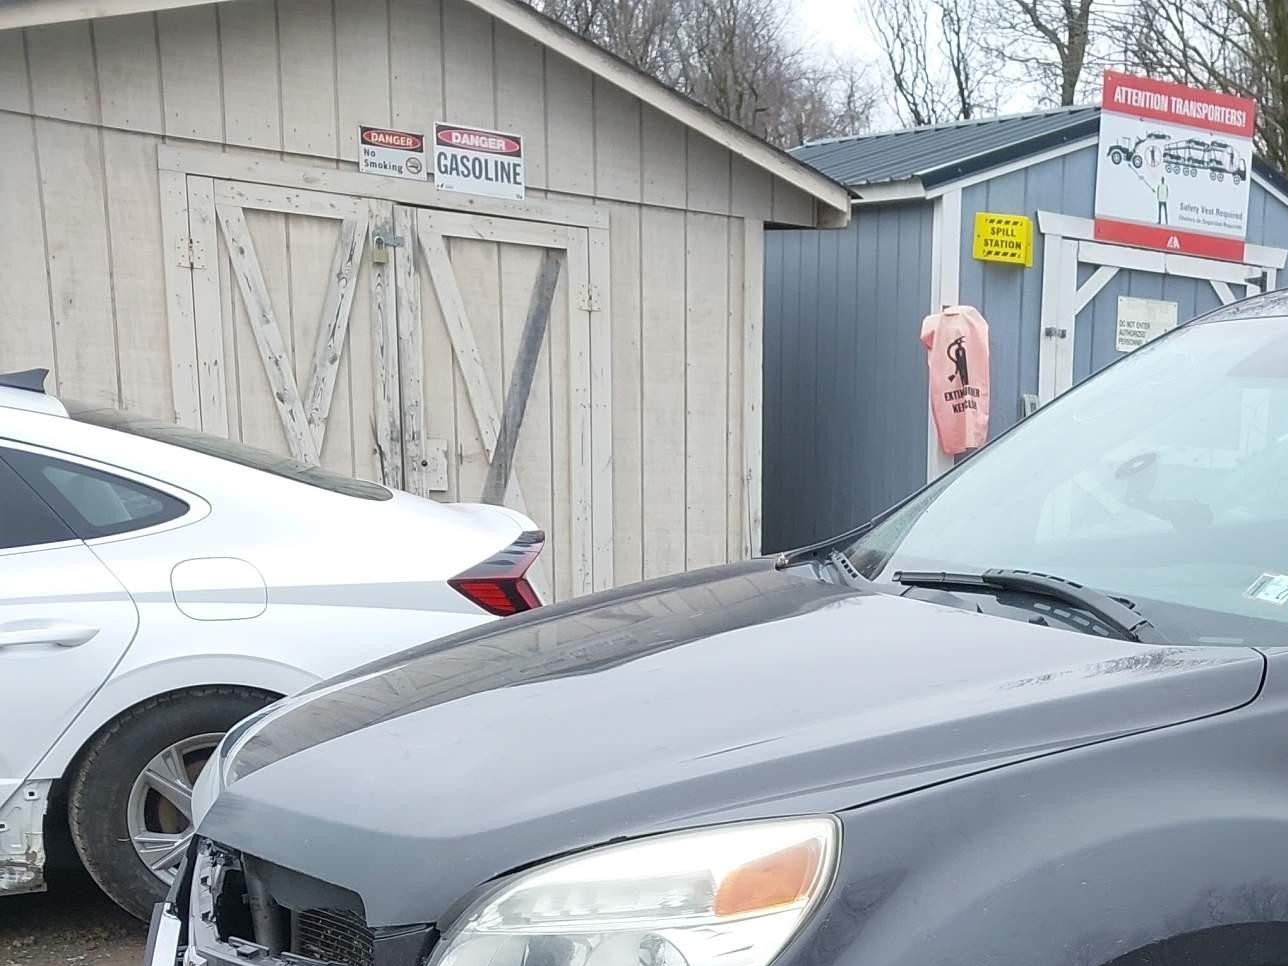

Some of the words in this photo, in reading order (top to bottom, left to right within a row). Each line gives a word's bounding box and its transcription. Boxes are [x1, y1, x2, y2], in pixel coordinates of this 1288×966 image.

[1114, 85, 1168, 112] ATTENTION
[1170, 97, 1246, 127] TRANSPORTERS!
[371, 132, 413, 146] DANGER
[451, 132, 506, 150] DANGER
[363, 148, 376, 158] No
[364, 158, 403, 174] Smoking
[437, 151, 522, 185] GASOLINE
[1180, 202, 1199, 214] Safety
[1200, 205, 1214, 215] Vest
[1215, 208, 1243, 221] Required
[990, 227, 1016, 237] SPILL
[983, 239, 1022, 250] STATION
[1126, 320, 1135, 328] NOT
